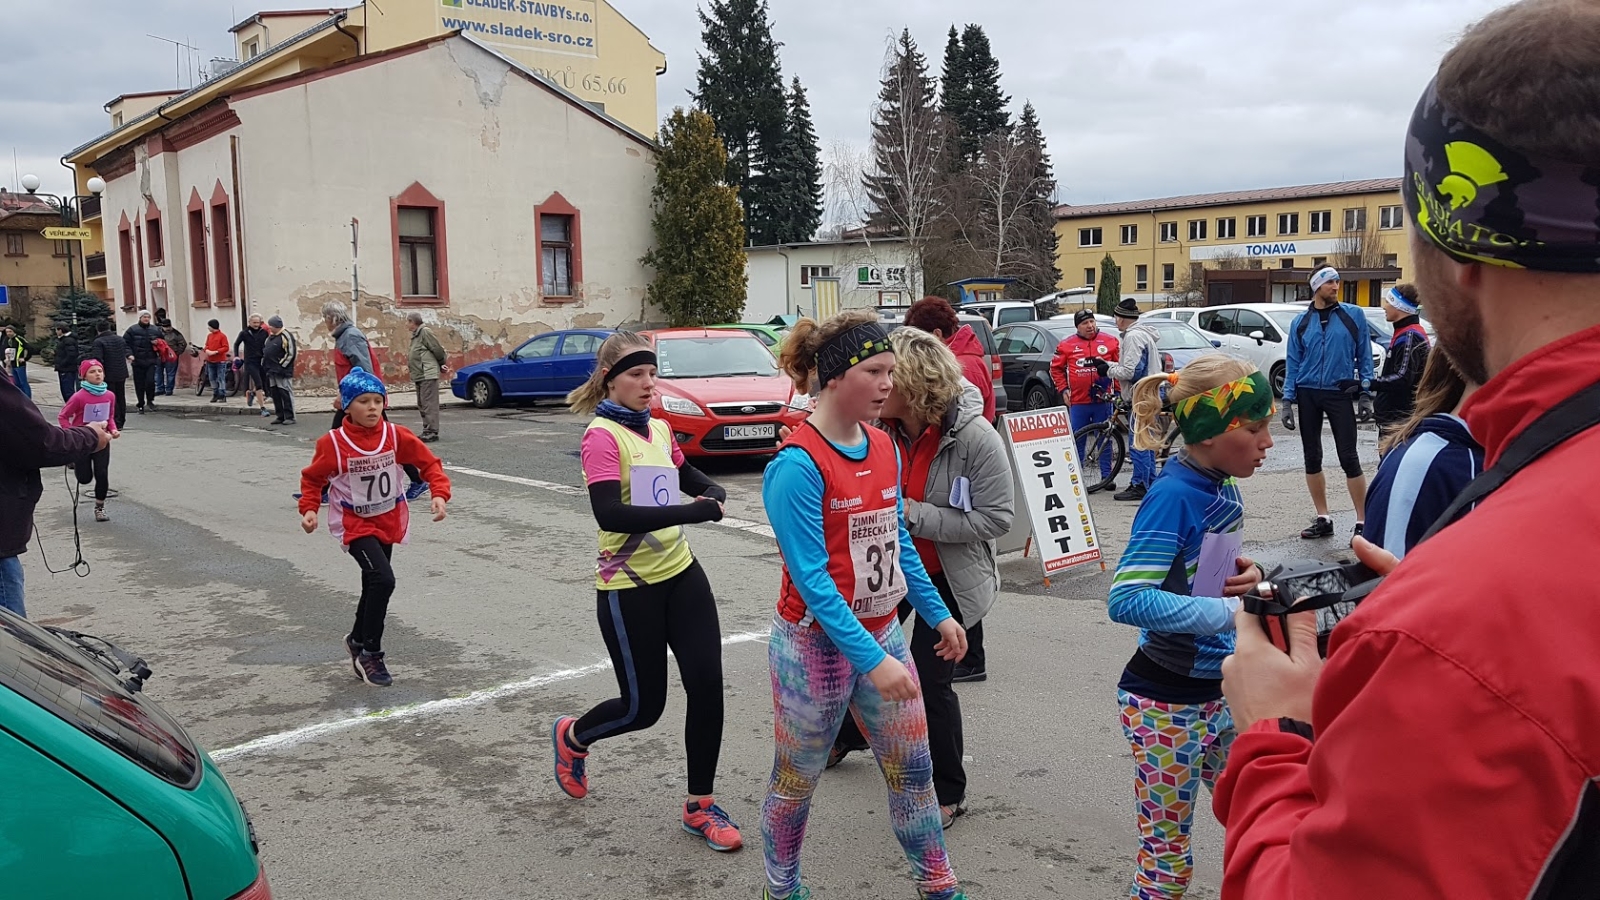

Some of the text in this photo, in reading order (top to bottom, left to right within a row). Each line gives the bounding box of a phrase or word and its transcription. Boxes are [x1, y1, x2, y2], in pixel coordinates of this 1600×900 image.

[441, 16, 594, 48] www.sladek-sro.cz
[582, 73, 627, 95] 65,66
[1246, 243, 1297, 256] TONAVA
[92, 404, 101, 418] 4
[1007, 412, 1068, 432] MARATON
[1053, 427, 1068, 435] stav
[730, 426, 773, 437] DKL SY90
[349, 458, 371, 466] ZIMNÍ
[382, 459, 394, 469] LIGA
[360, 471, 391, 502] 70
[652, 474, 670, 506] 6
[1031, 450, 1071, 554] START
[852, 512, 878, 528] ZIMNÍ
[851, 522, 888, 540] BĚŽECKÁ
[866, 540, 896, 593] 37
[1046, 551, 1099, 569] www.maratonstav.cz
